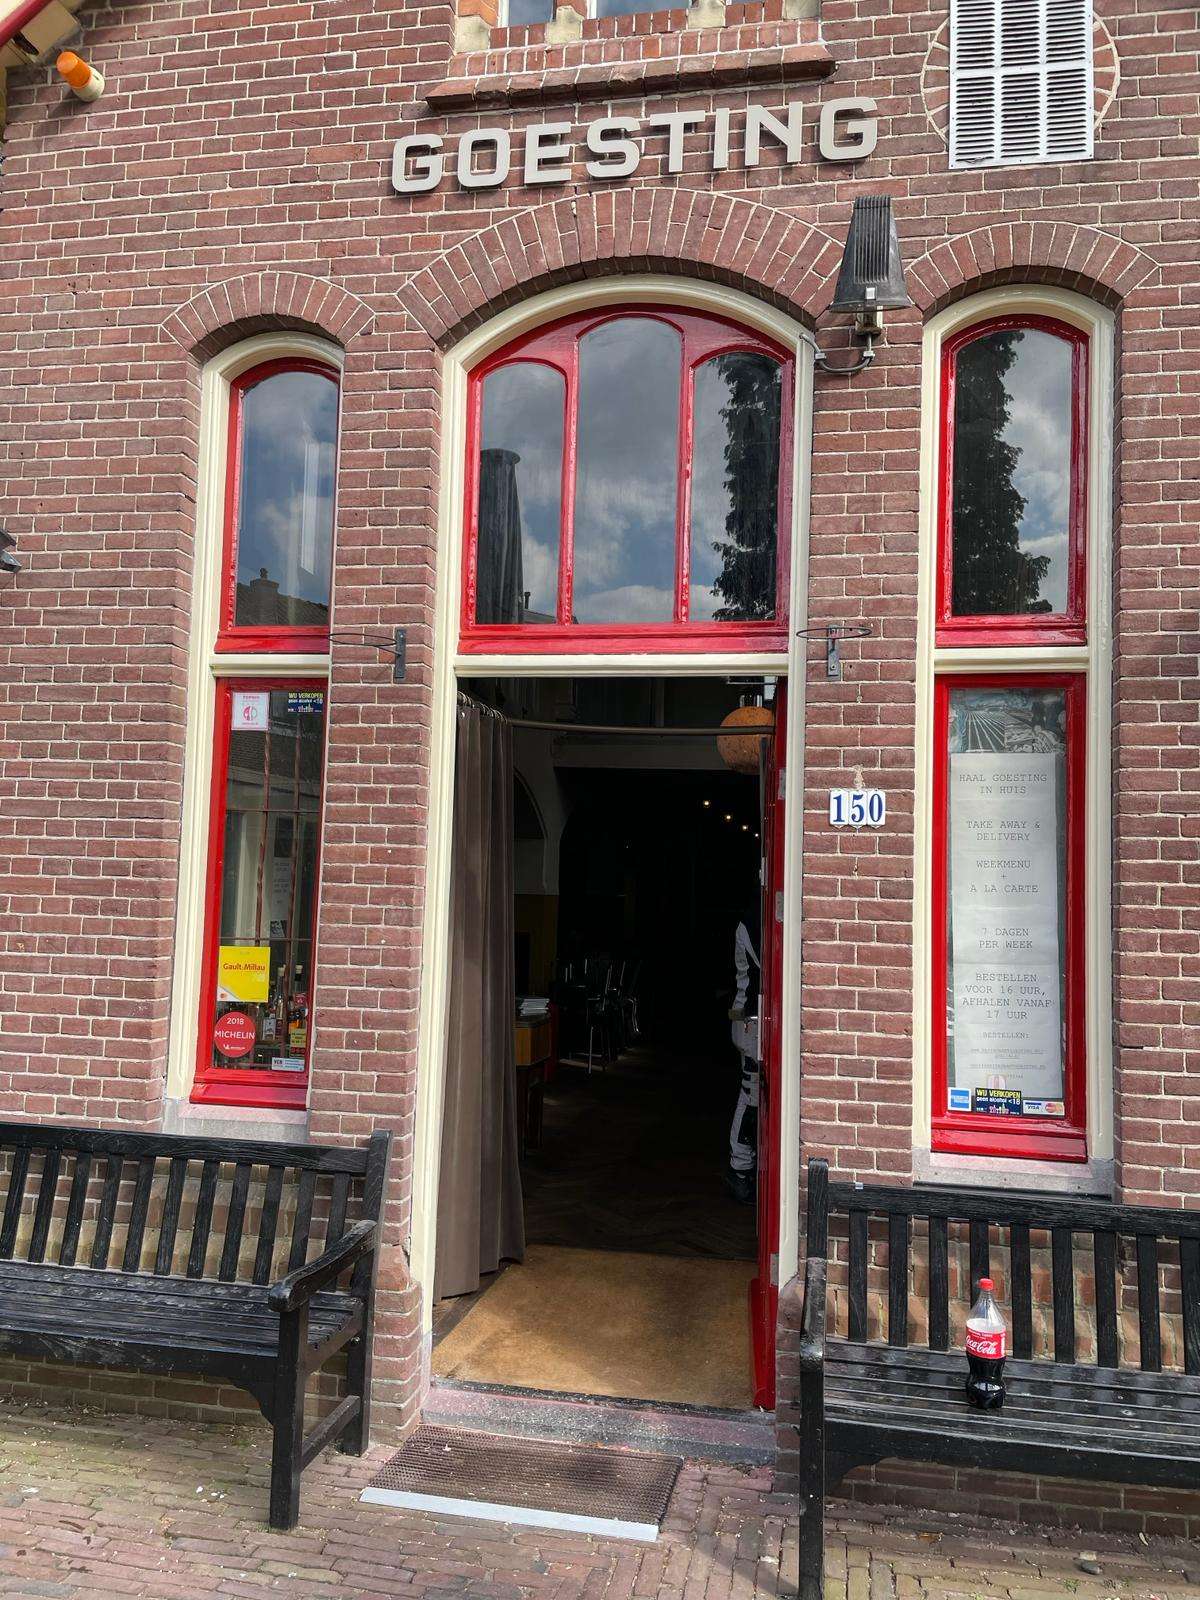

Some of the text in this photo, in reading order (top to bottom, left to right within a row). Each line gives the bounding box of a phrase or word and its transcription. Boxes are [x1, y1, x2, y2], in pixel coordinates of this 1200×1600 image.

[391, 96, 879, 193] GOESTING
[959, 774, 1047, 782] HAAL GOESTING
[980, 786, 1027, 794] IN HUIS
[833, 793, 883, 823] 150
[967, 821, 993, 829] TAKE
[1000, 821, 1027, 829] AWAY
[976, 833, 1030, 841] DELIVERY
[976, 860, 1031, 869] WEEKMENU
[984, 885, 998, 893] LA
[1004, 885, 1039, 893] CARTE
[995, 928, 1029, 936] DAGEN
[979, 941, 1033, 949] PER WEEK
[976, 973, 1037, 982] BESTELLEN
[965, 985, 993, 994] VOOR
[1000, 986, 1014, 994] 16
[962, 998, 1051, 1008] AFHALEN VANAF
[986, 1011, 1028, 1020] 17 UUR
[215, 1031, 255, 1039] MICHELIN
[989, 1090, 1021, 1099] VERKOPEN
